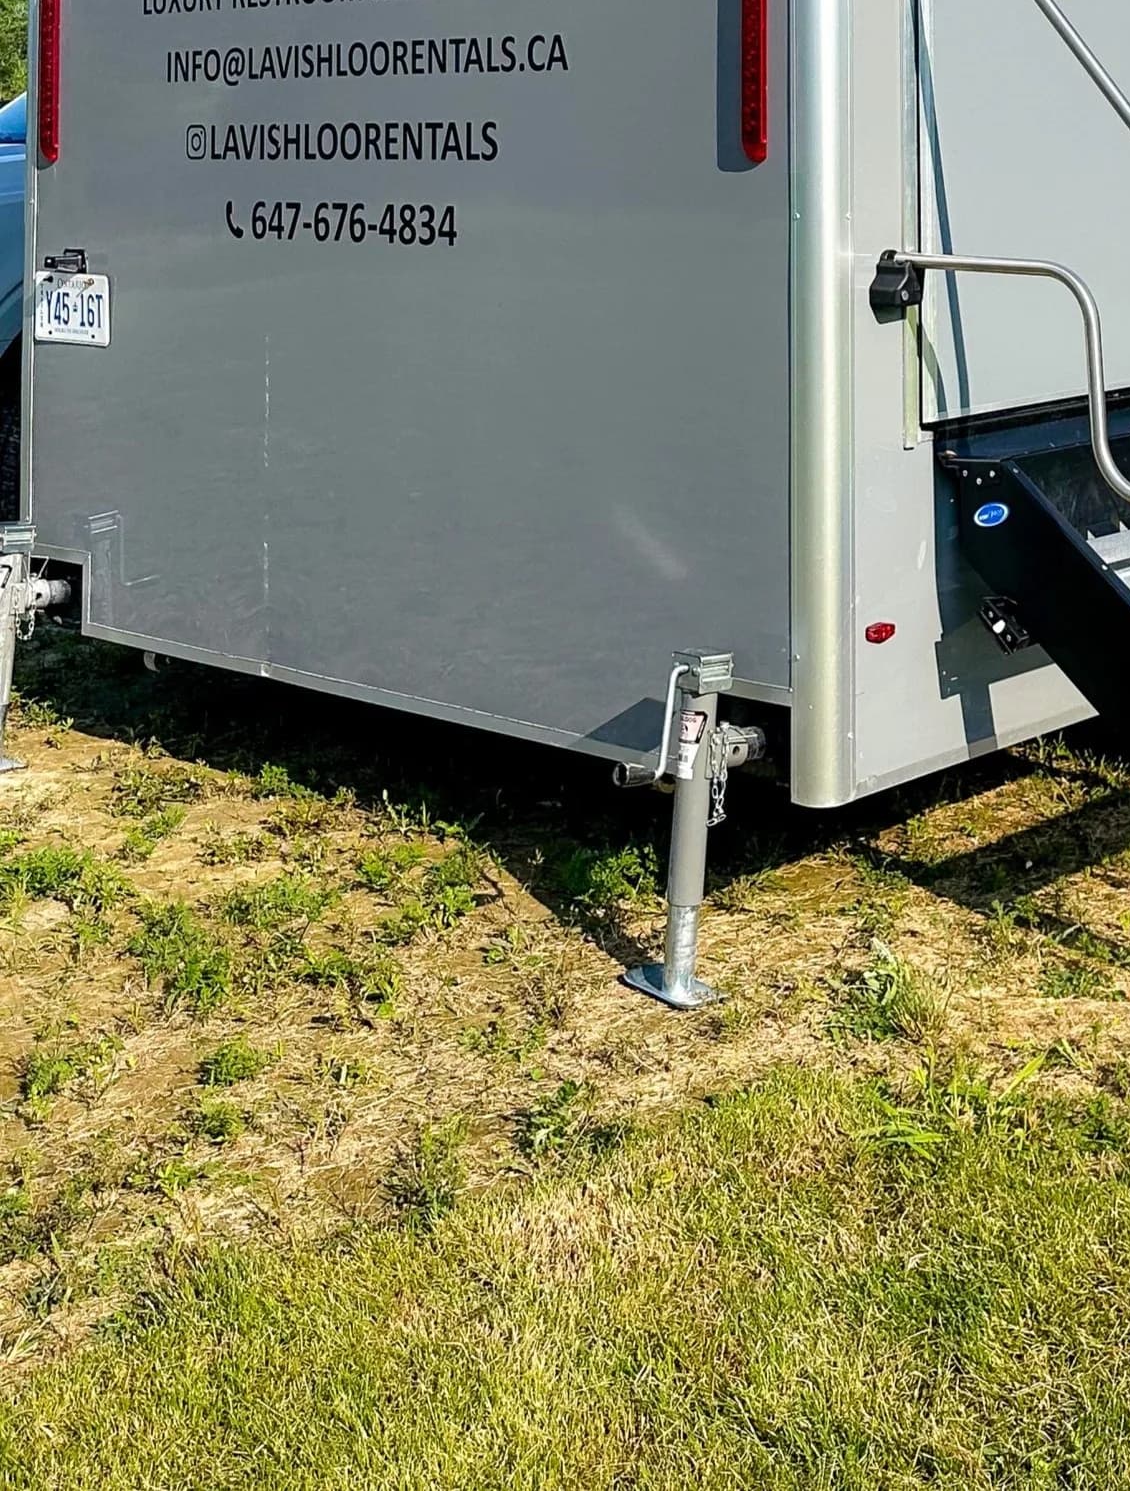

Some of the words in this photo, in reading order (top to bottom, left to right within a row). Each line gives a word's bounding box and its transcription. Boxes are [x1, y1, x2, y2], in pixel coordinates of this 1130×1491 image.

[167, 34, 569, 87] INFO@LAVISHLOORENTALS.CA
[210, 121, 499, 162] LAVISHLOORENTALS
[251, 200, 458, 247] 647-676-4834
